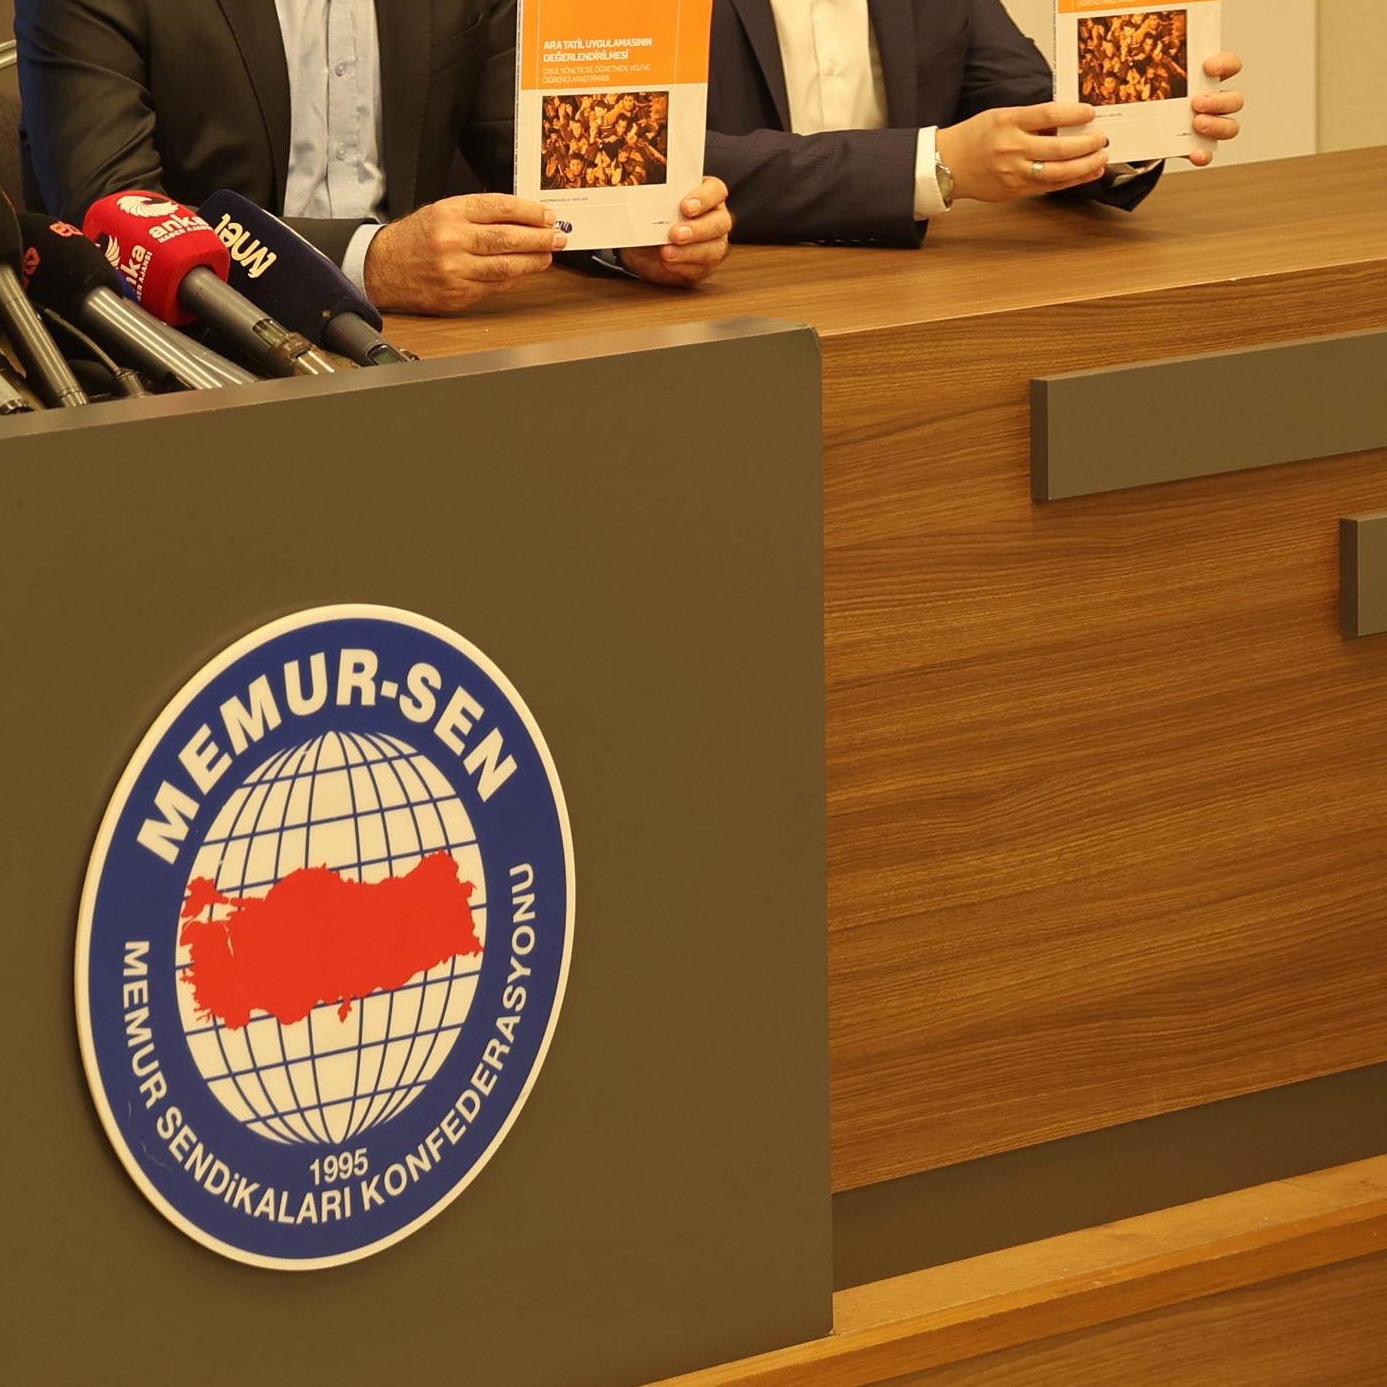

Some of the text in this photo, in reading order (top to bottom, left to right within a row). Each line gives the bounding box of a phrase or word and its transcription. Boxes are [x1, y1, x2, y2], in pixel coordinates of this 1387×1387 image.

[544, 41, 562, 50] ARA
[137, 648, 518, 865] MEMUR-SEN
[122, 941, 168, 1108] MEMUR
[362, 862, 536, 1212] KONFEDERASYONU
[309, 1147, 369, 1186] 1995
